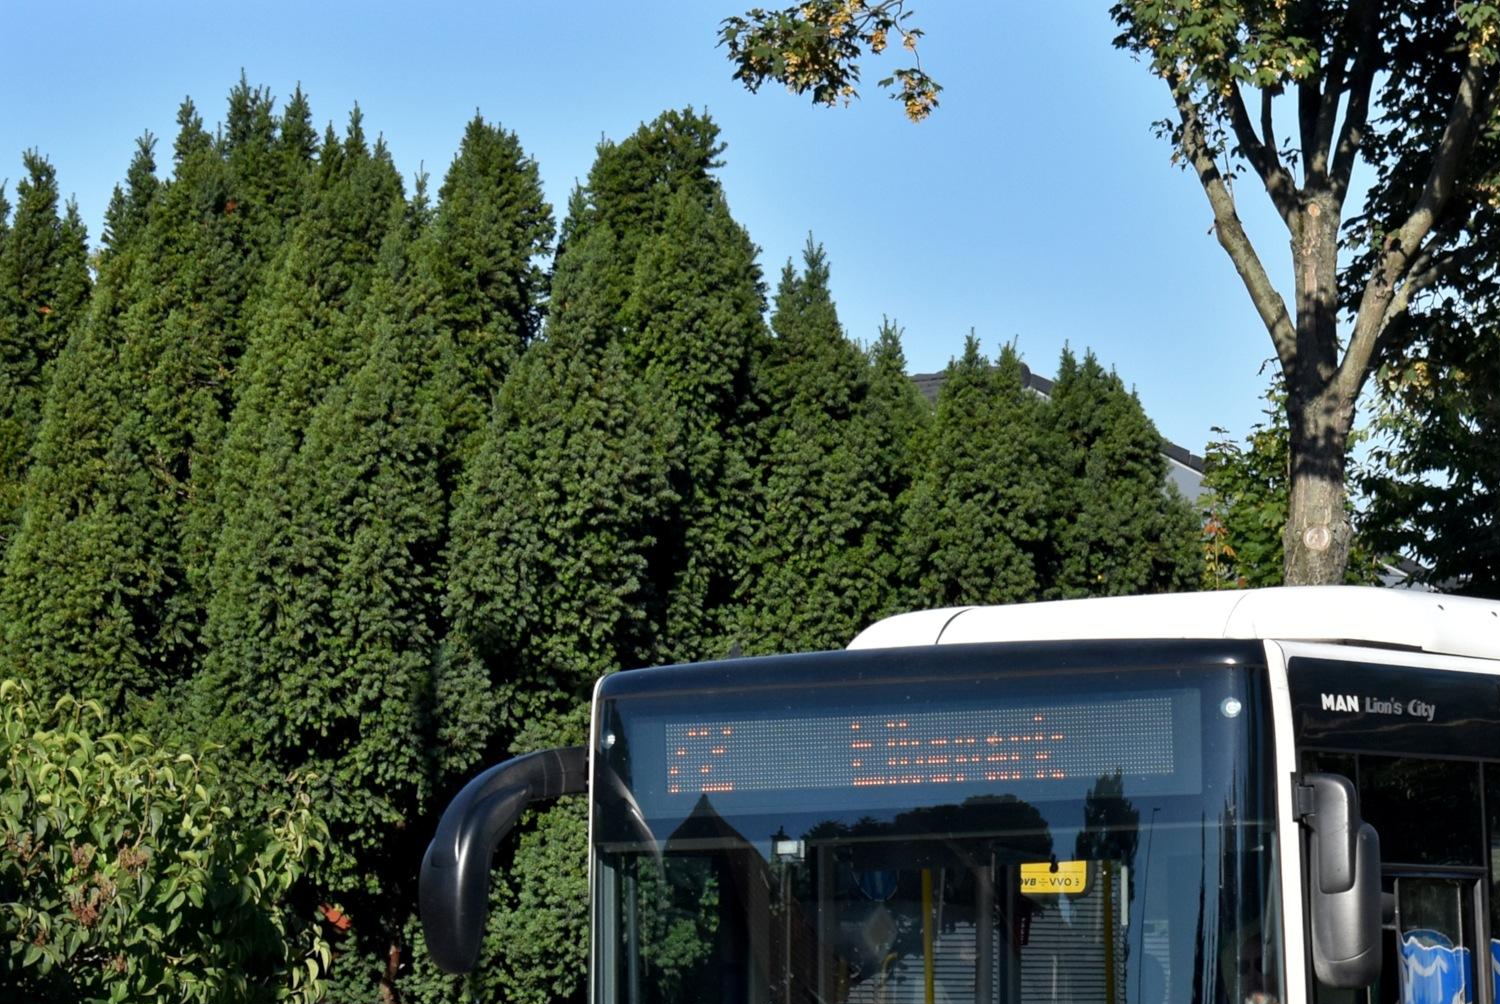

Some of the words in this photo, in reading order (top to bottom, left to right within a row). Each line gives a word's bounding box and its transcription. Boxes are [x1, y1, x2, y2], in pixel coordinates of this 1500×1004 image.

[1321, 693, 1359, 712] MAN
[1365, 697, 1402, 715] Lion's
[1407, 699, 1435, 721] City
[1049, 878, 1072, 887] VVO
